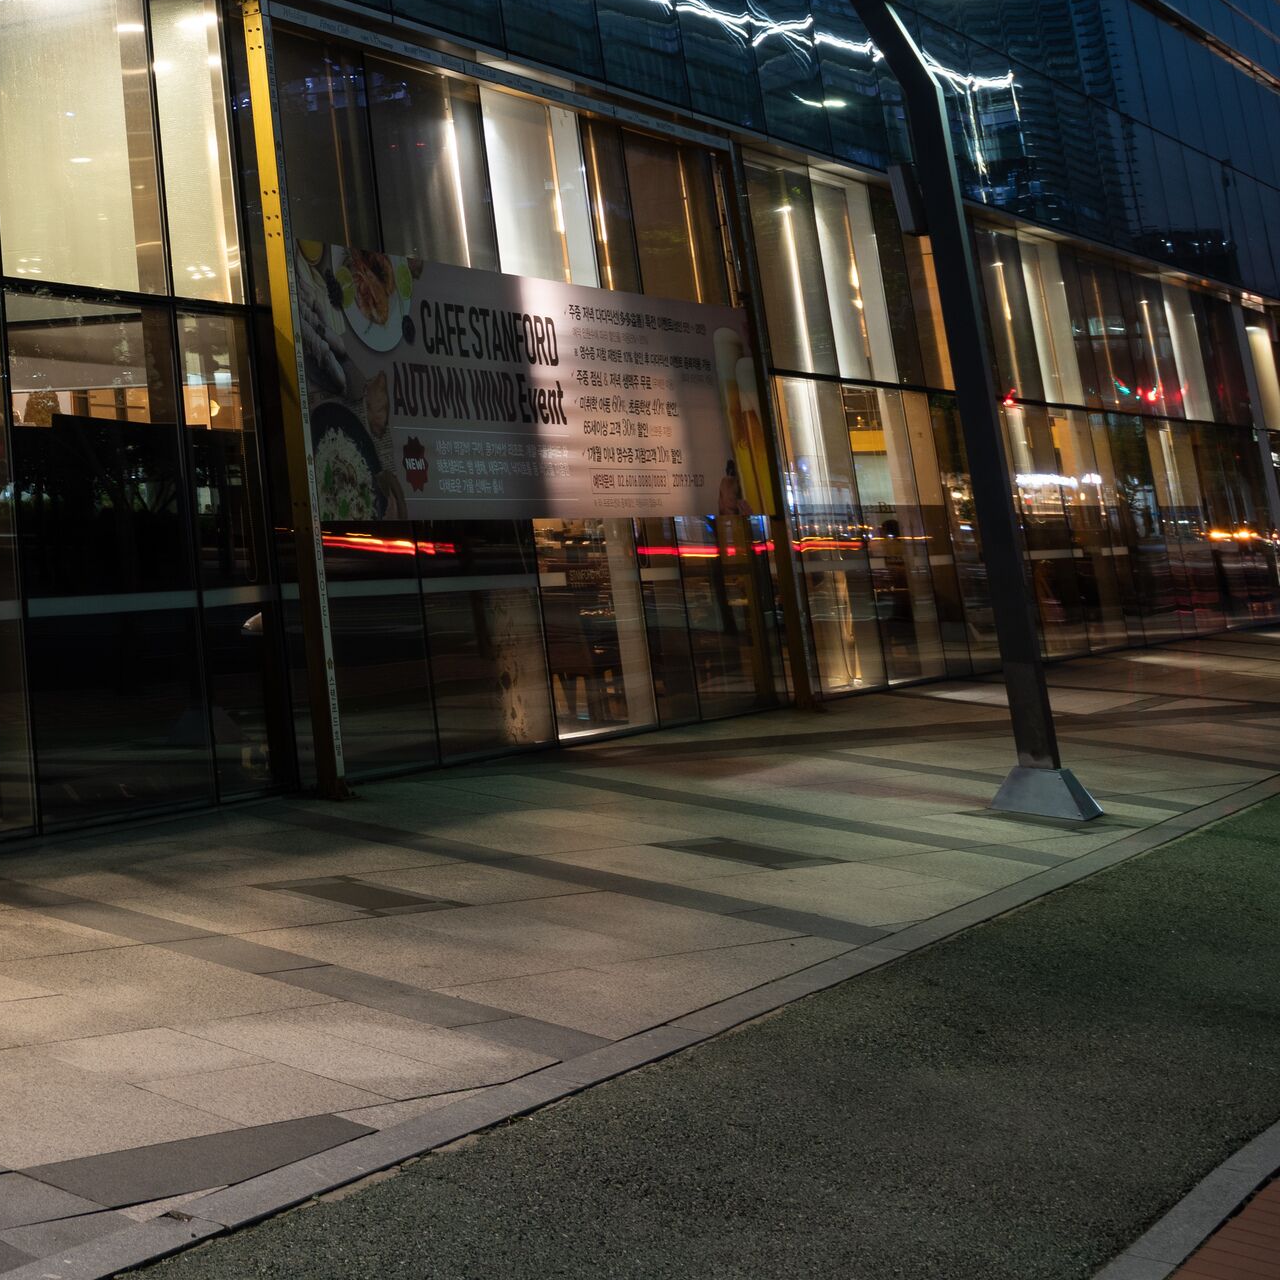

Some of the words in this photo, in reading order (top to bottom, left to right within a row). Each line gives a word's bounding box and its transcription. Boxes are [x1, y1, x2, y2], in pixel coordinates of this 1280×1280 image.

[568, 304, 582, 320] 주중
[582, 306, 595, 322] 저녁
[420, 299, 470, 358] CAFE
[469, 306, 560, 367] STANFORD
[580, 345, 595, 360] 영수증
[576, 369, 589, 386] 주중
[590, 370, 603, 387] 점심
[609, 372, 622, 388] 저녁
[640, 375, 653, 390] 무료
[393, 361, 470, 420] AUTUMN
[469, 368, 519, 423] WIND
[516, 373, 568, 426] Event
[405, 458, 426, 471] NEW!
[309, 471, 323, 561] STANFORD
